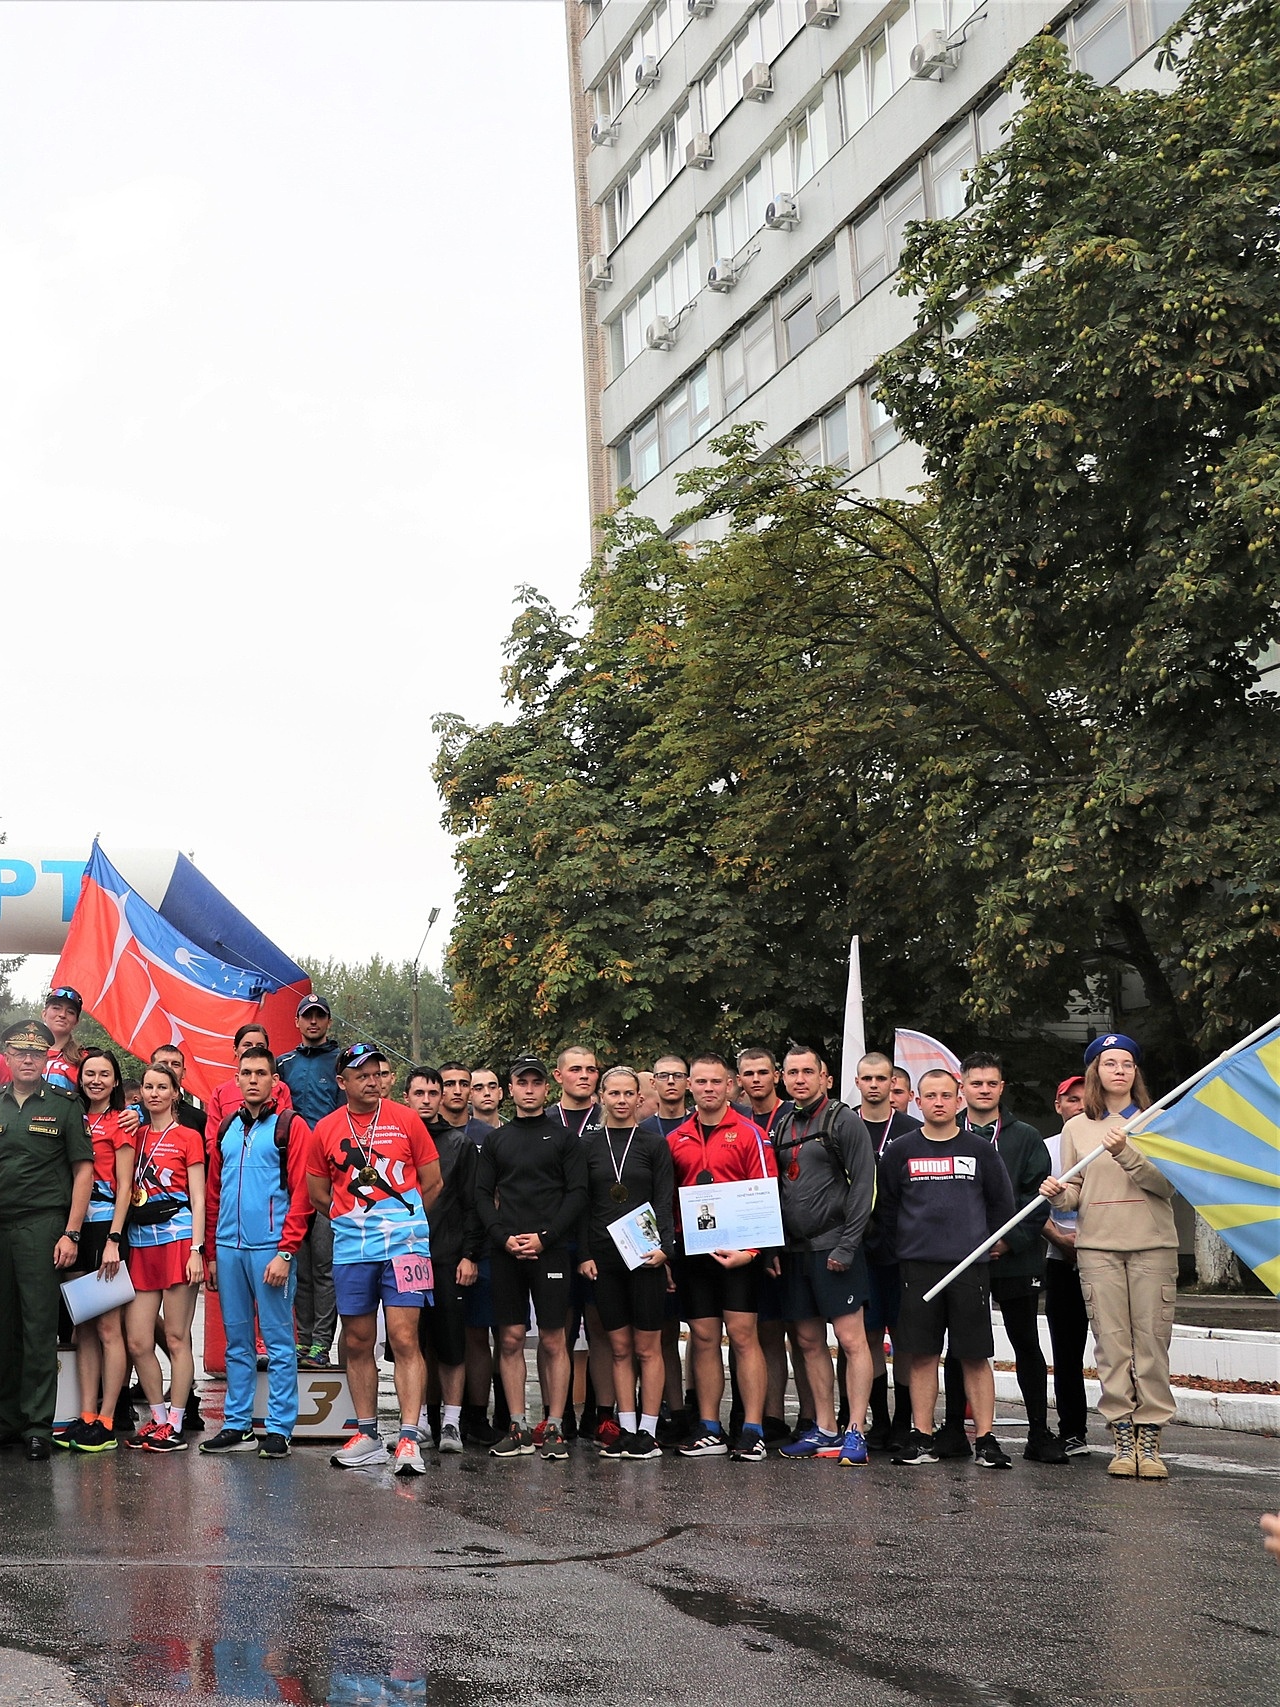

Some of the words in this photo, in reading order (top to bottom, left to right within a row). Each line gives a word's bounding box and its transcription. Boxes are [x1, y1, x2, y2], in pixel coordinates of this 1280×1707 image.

[910, 1160, 951, 1174] PUMA
[403, 1264, 430, 1282] 309
[296, 1382, 343, 1425] 3
